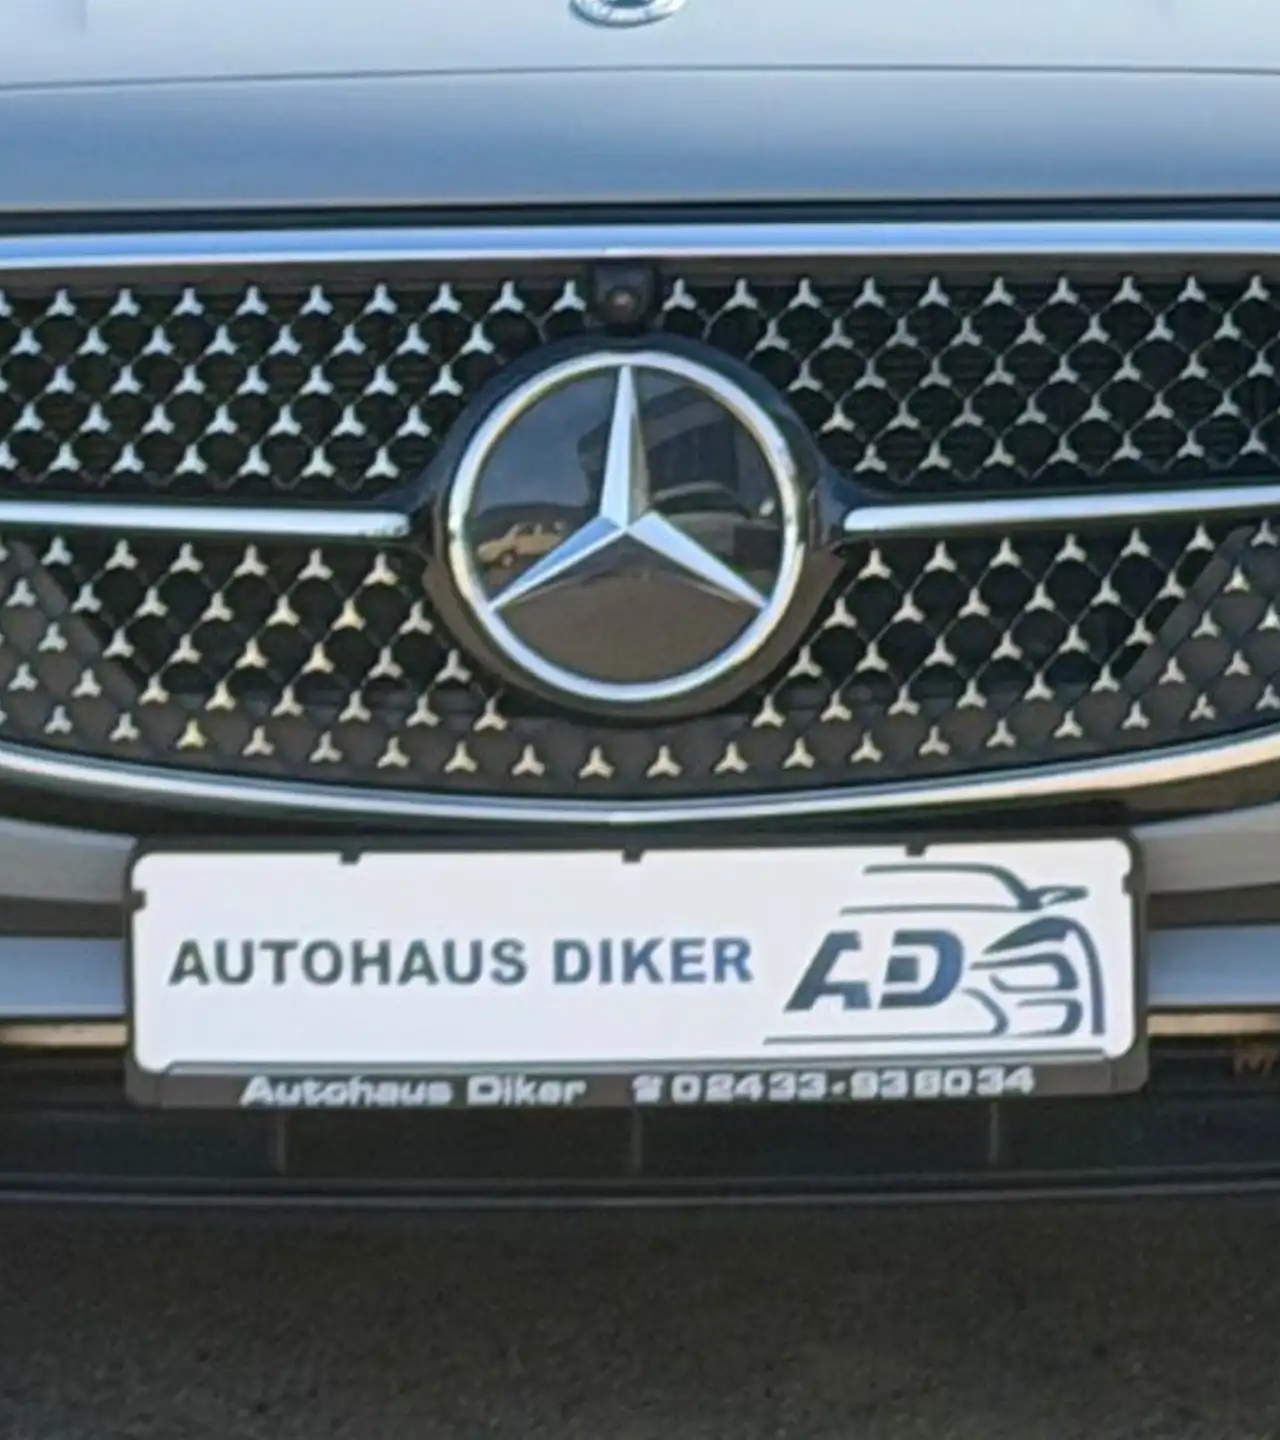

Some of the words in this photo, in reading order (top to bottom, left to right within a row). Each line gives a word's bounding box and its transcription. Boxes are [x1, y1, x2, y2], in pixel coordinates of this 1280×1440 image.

[167, 938, 528, 987] AUTOHAUS
[551, 936, 754, 985] DIKER
[782, 928, 966, 1013] AD
[239, 1074, 454, 1107] Autohaus
[466, 1073, 588, 1106] Diker
